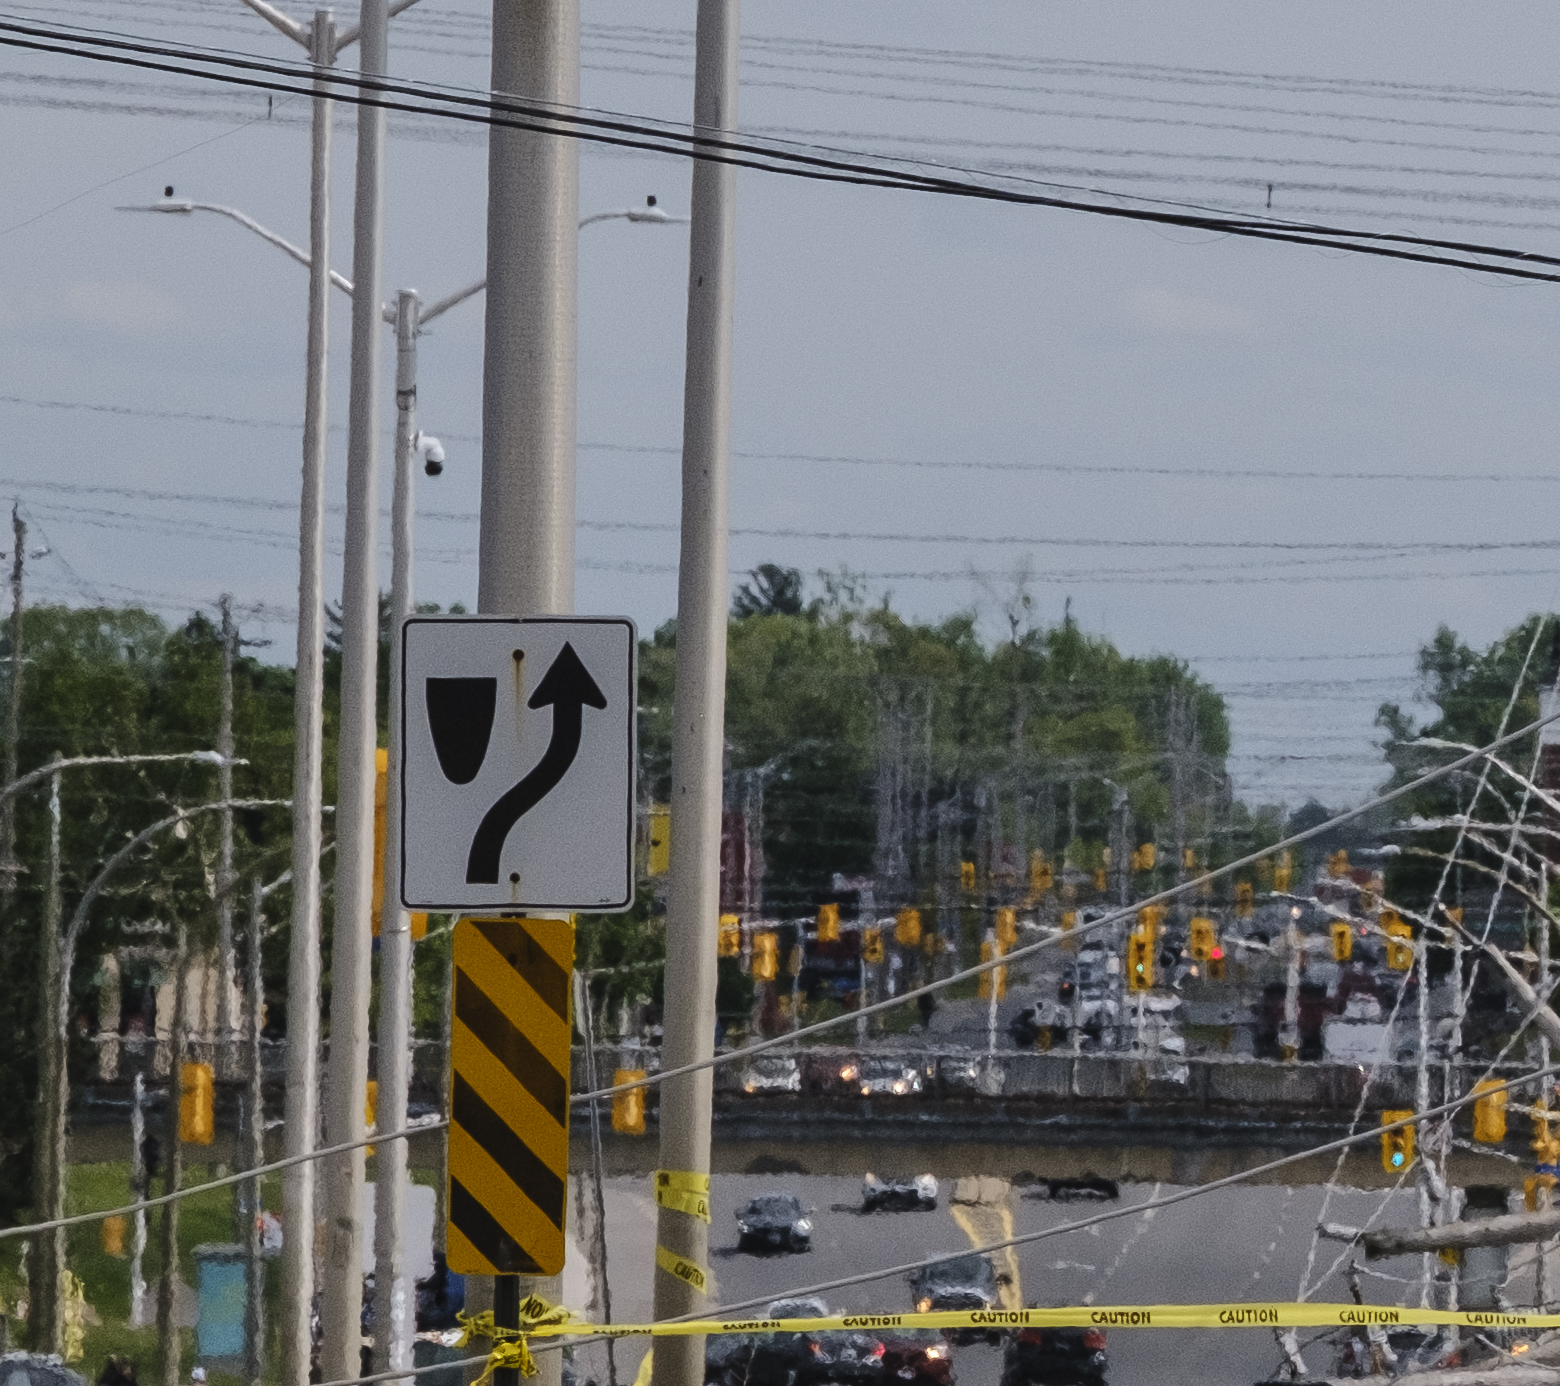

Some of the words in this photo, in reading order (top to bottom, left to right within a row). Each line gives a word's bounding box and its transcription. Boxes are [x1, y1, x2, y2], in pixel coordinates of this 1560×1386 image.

[842, 1316, 903, 1327] CAUTION
[970, 1311, 1030, 1324] CAUTION
[1090, 1311, 1151, 1326] CAUTION
[1219, 1309, 1279, 1324] CAUTION
[1339, 1310, 1400, 1324] CAUTION
